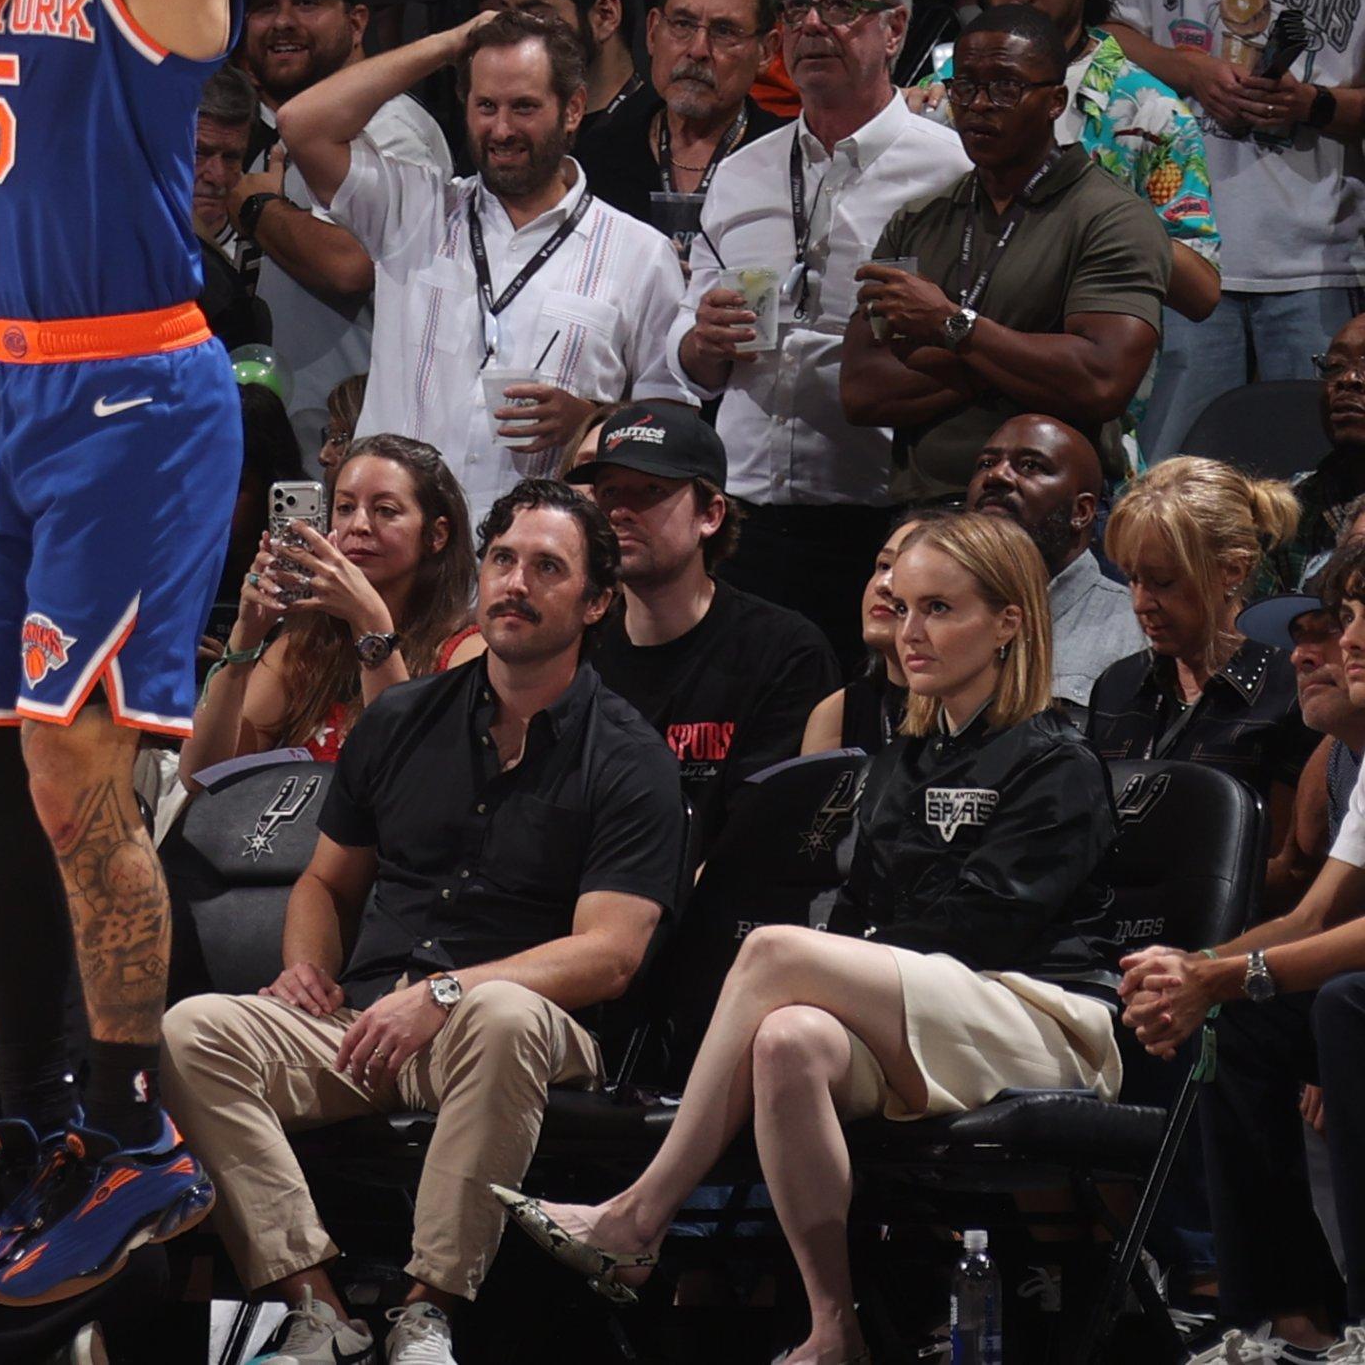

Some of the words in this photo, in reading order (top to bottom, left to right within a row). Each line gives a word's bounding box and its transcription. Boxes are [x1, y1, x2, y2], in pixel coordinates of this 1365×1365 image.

[666, 720, 735, 762] SPURS
[927, 791, 952, 803] SAN
[954, 791, 998, 804] ANTONIO
